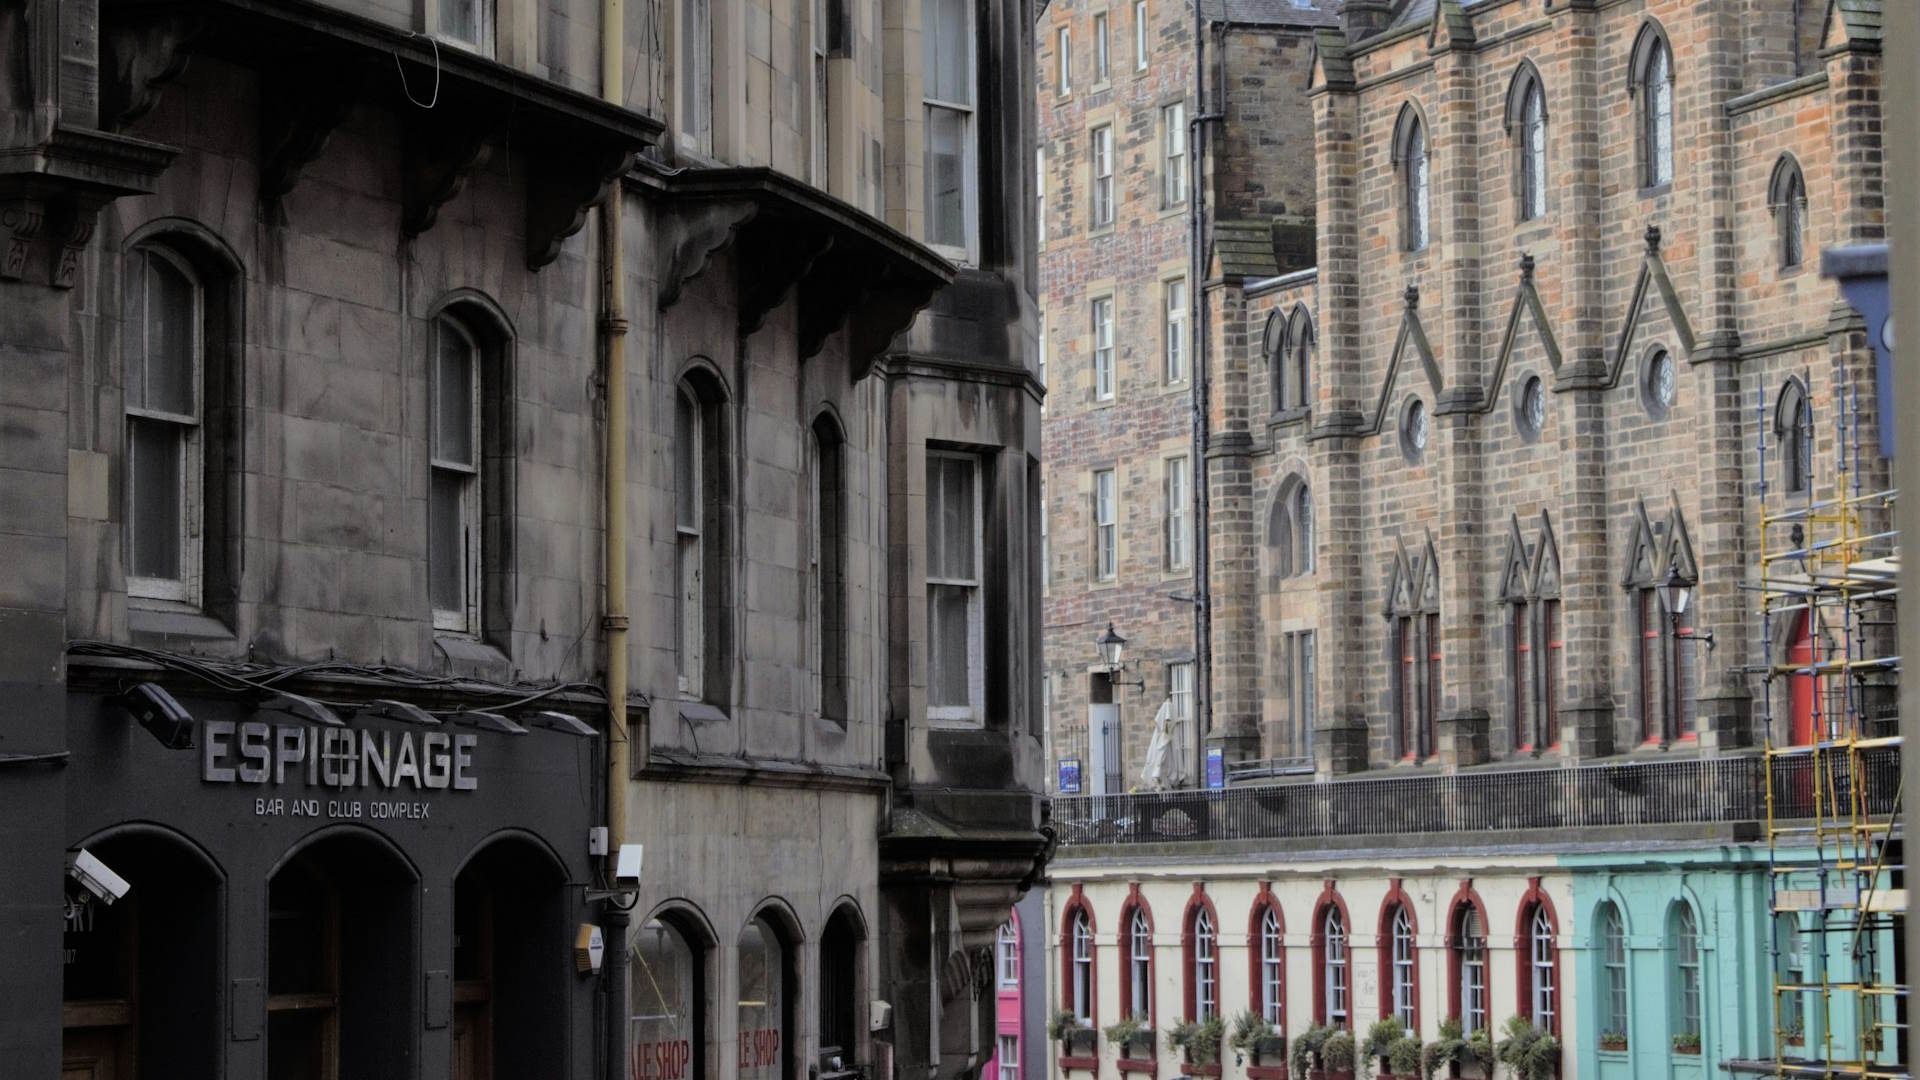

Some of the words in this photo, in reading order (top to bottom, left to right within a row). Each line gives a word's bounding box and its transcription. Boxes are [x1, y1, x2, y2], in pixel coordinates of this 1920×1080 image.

[204, 720, 478, 791] ESPIONAGE
[255, 797, 285, 816] BAR
[291, 799, 320, 817] AND
[328, 800, 362, 818] CLUB
[370, 802, 430, 819] COMPLEX
[655, 1040, 690, 1080] SHOP
[753, 1029, 779, 1067] SHOP
